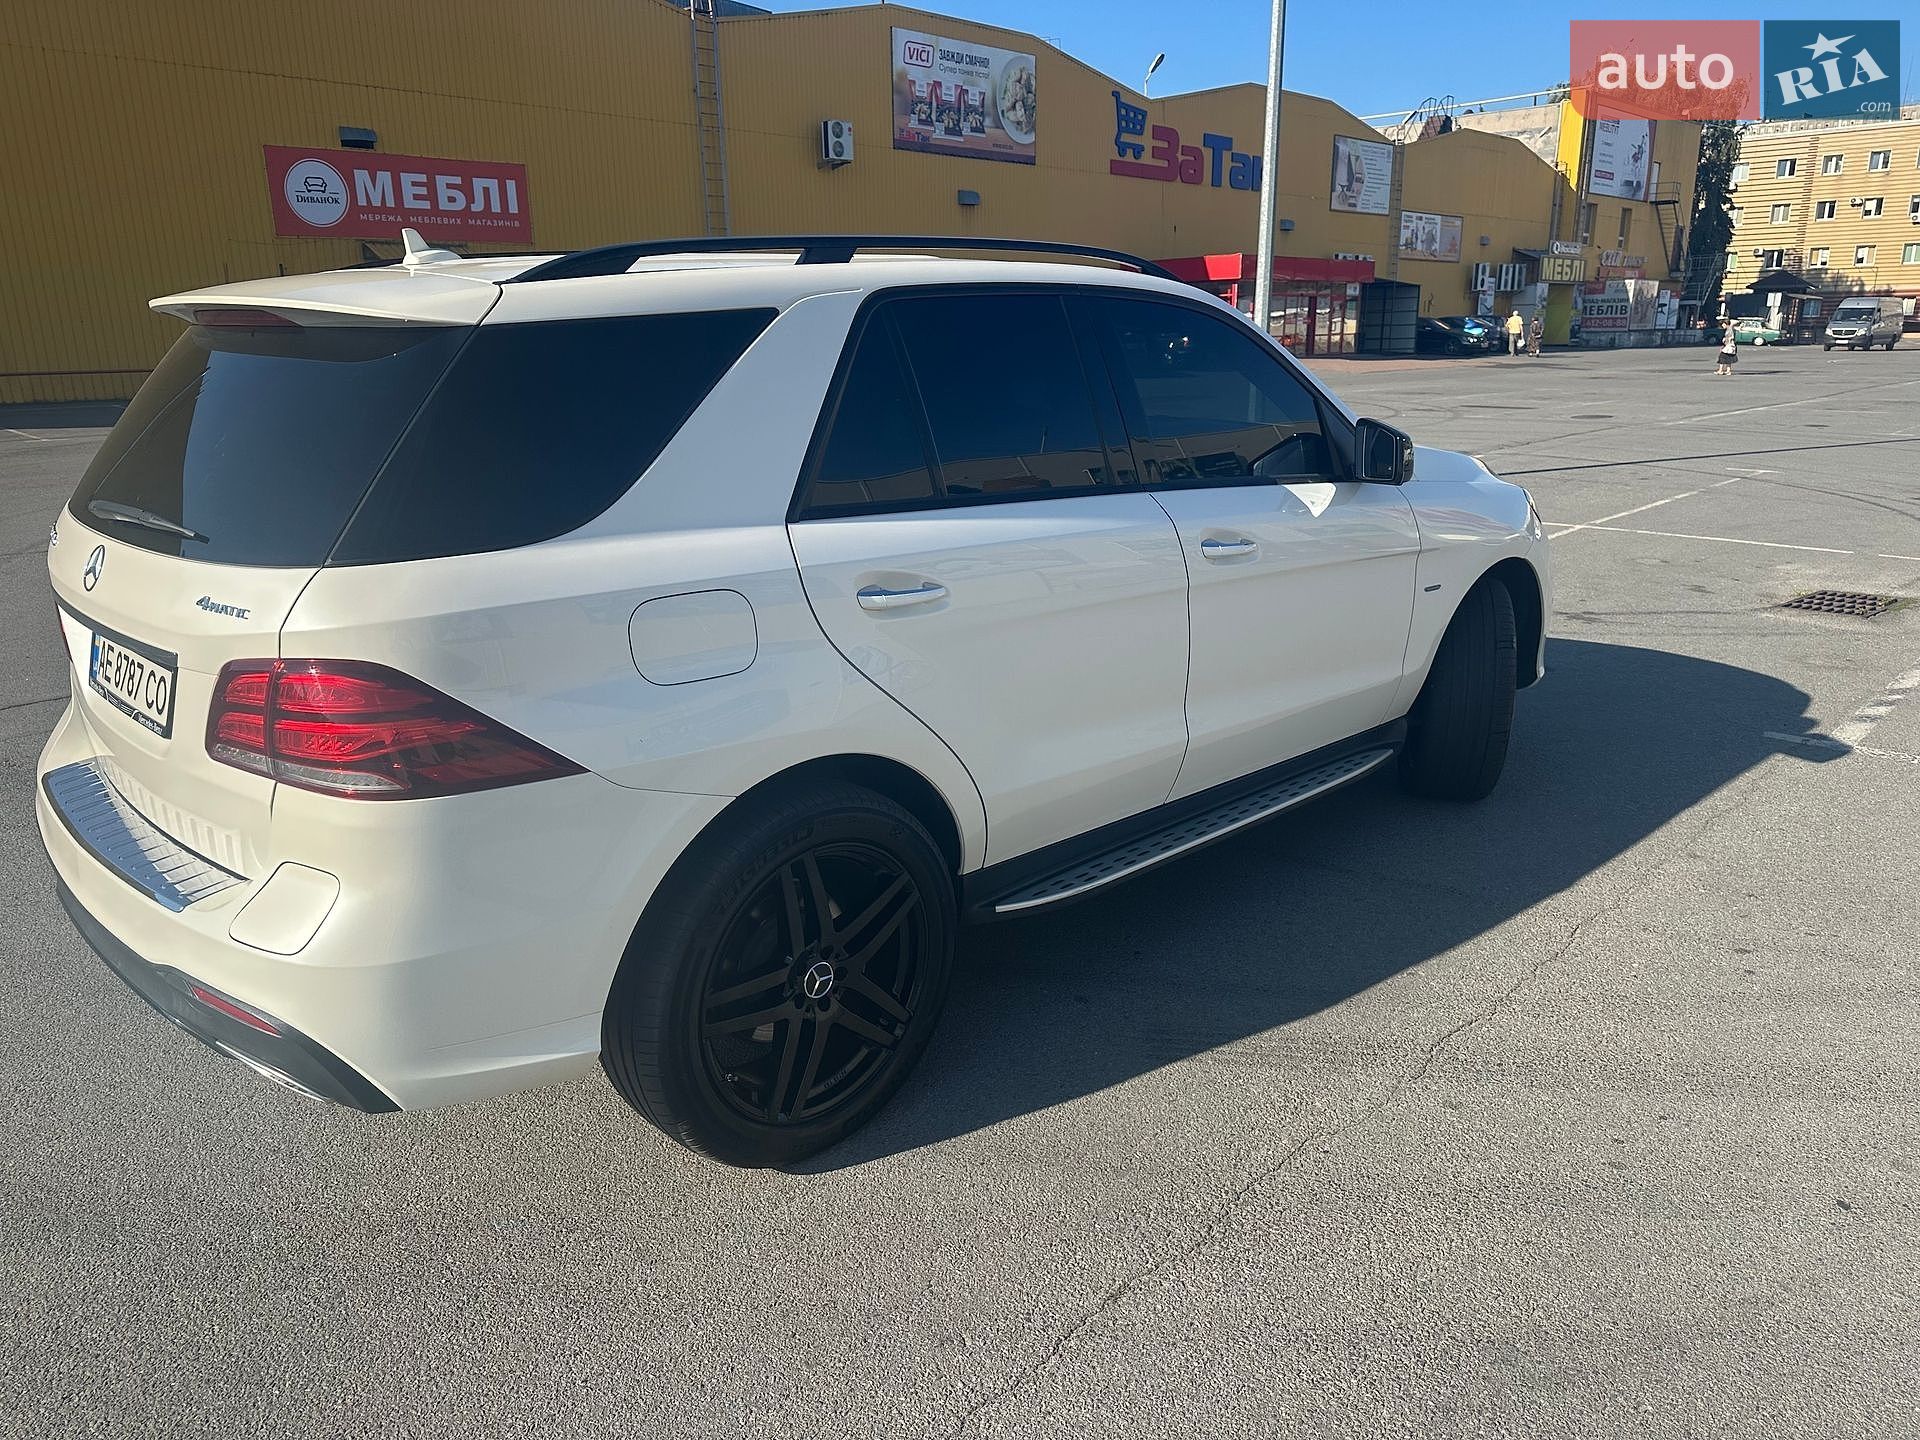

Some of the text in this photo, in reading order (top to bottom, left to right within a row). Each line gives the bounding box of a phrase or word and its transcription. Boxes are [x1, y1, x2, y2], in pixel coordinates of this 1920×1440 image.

[938, 49, 964, 64] ЗАВЖДИ
[353, 169, 519, 214] МЕБЛІ
[360, 213, 403, 222] МЕРЕЖА
[409, 216, 462, 225] МЕБЛЕВИХ
[1542, 257, 1585, 282] МЕБЛІ
[196, 595, 251, 620] 4MATIC
[99, 641, 167, 715] AE 8787 CO
